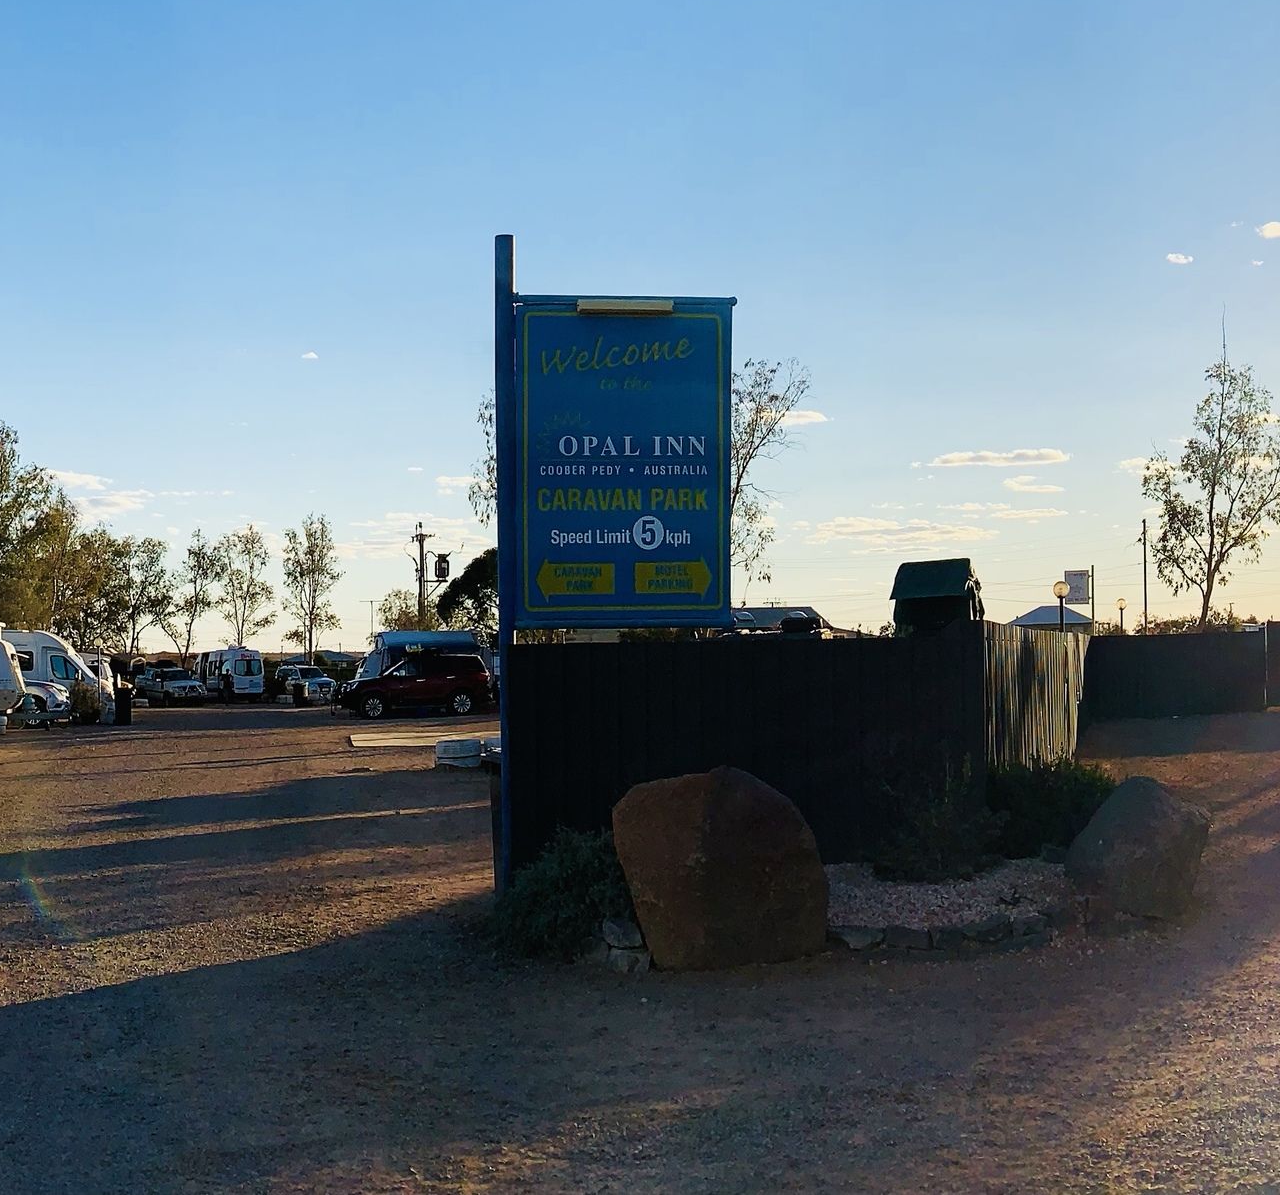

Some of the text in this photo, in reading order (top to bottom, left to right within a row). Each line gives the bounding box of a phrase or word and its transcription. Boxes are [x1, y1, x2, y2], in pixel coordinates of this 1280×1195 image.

[541, 335, 694, 375] Welcome
[558, 435, 706, 456] OPAL INN
[540, 465, 708, 476] COOBER PEDY AUSTRALIA
[537, 488, 708, 511] CARAVAN PARK
[550, 520, 691, 547] Speed Limit 5 kph
[554, 566, 602, 577] CARAVAN
[655, 564, 689, 576] MOTEL
[567, 580, 593, 591] PARK
[648, 579, 694, 590] PARKING
